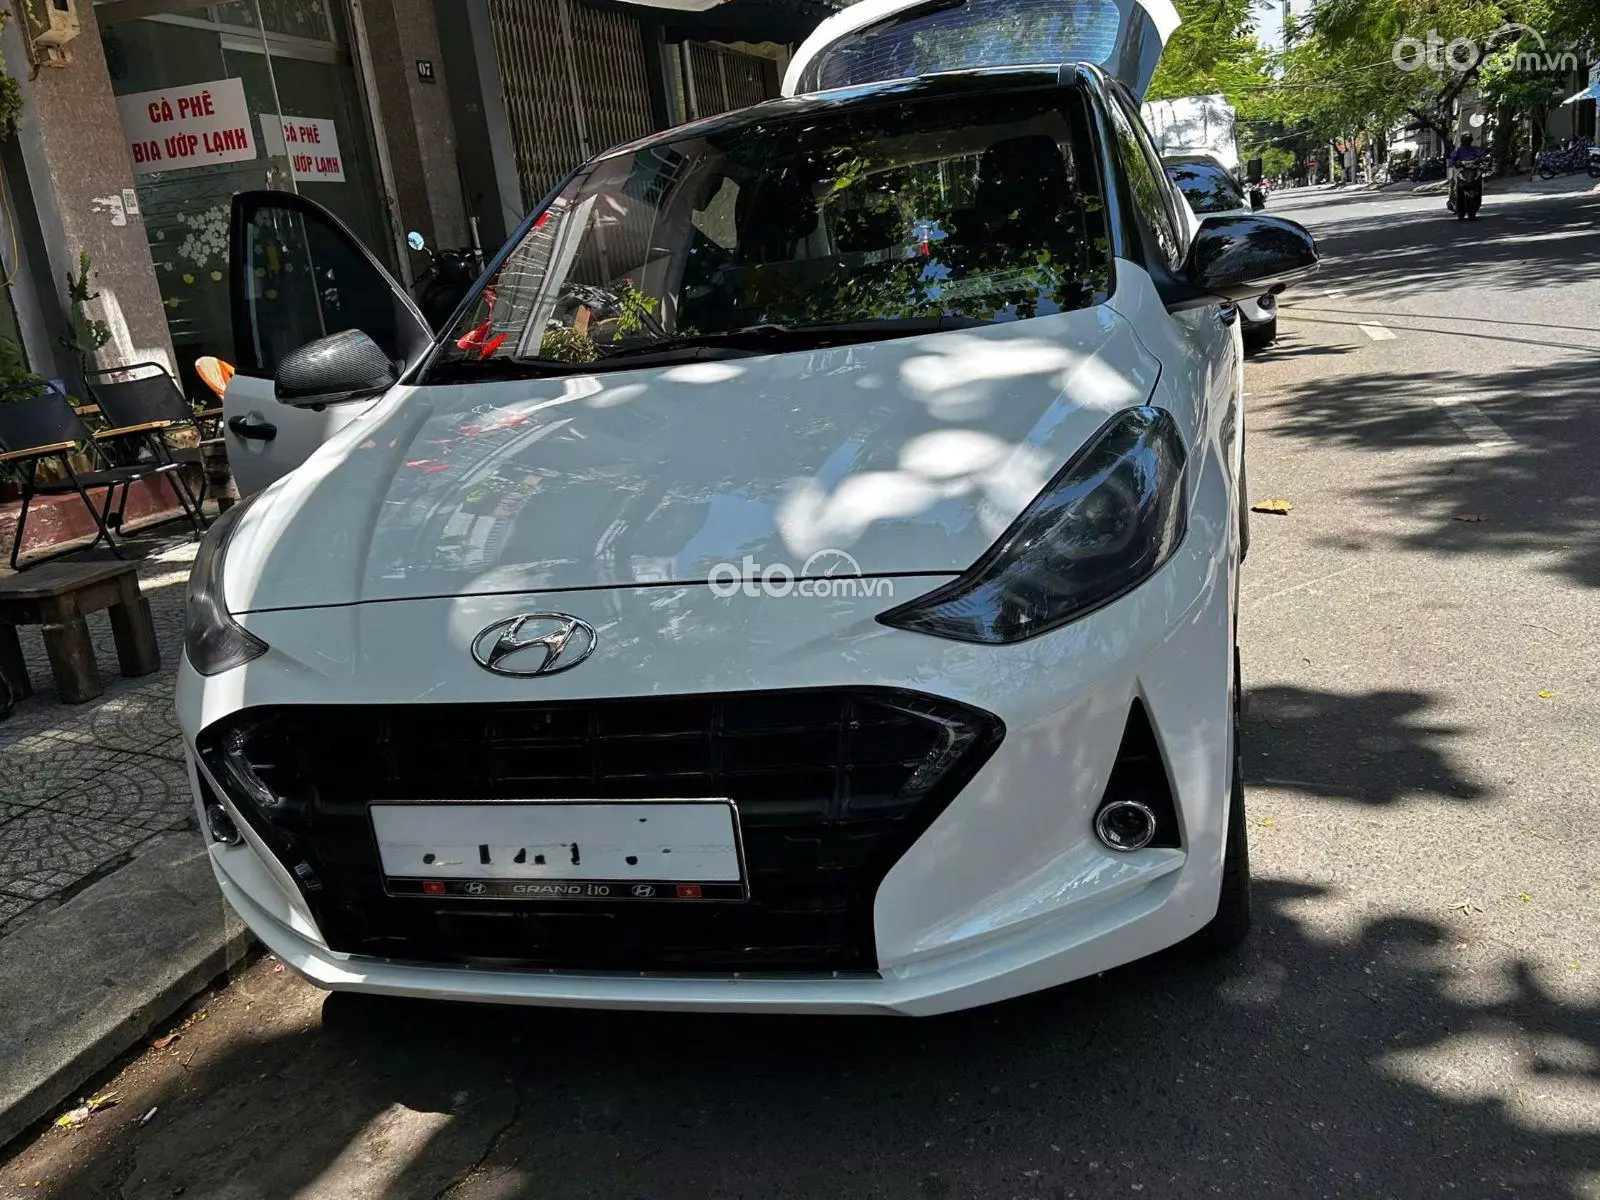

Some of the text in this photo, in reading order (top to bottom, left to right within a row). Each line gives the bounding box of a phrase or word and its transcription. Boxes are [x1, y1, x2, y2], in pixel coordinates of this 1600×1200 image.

[419, 62, 430, 76] 07
[148, 90, 215, 123] CÀ PHÊ
[299, 124, 321, 144] PHÊ
[131, 128, 248, 163] BIA ƯỚP LẠNH
[293, 152, 339, 176] ƯỚP LẠNH
[512, 884, 610, 896] GRAND i10
